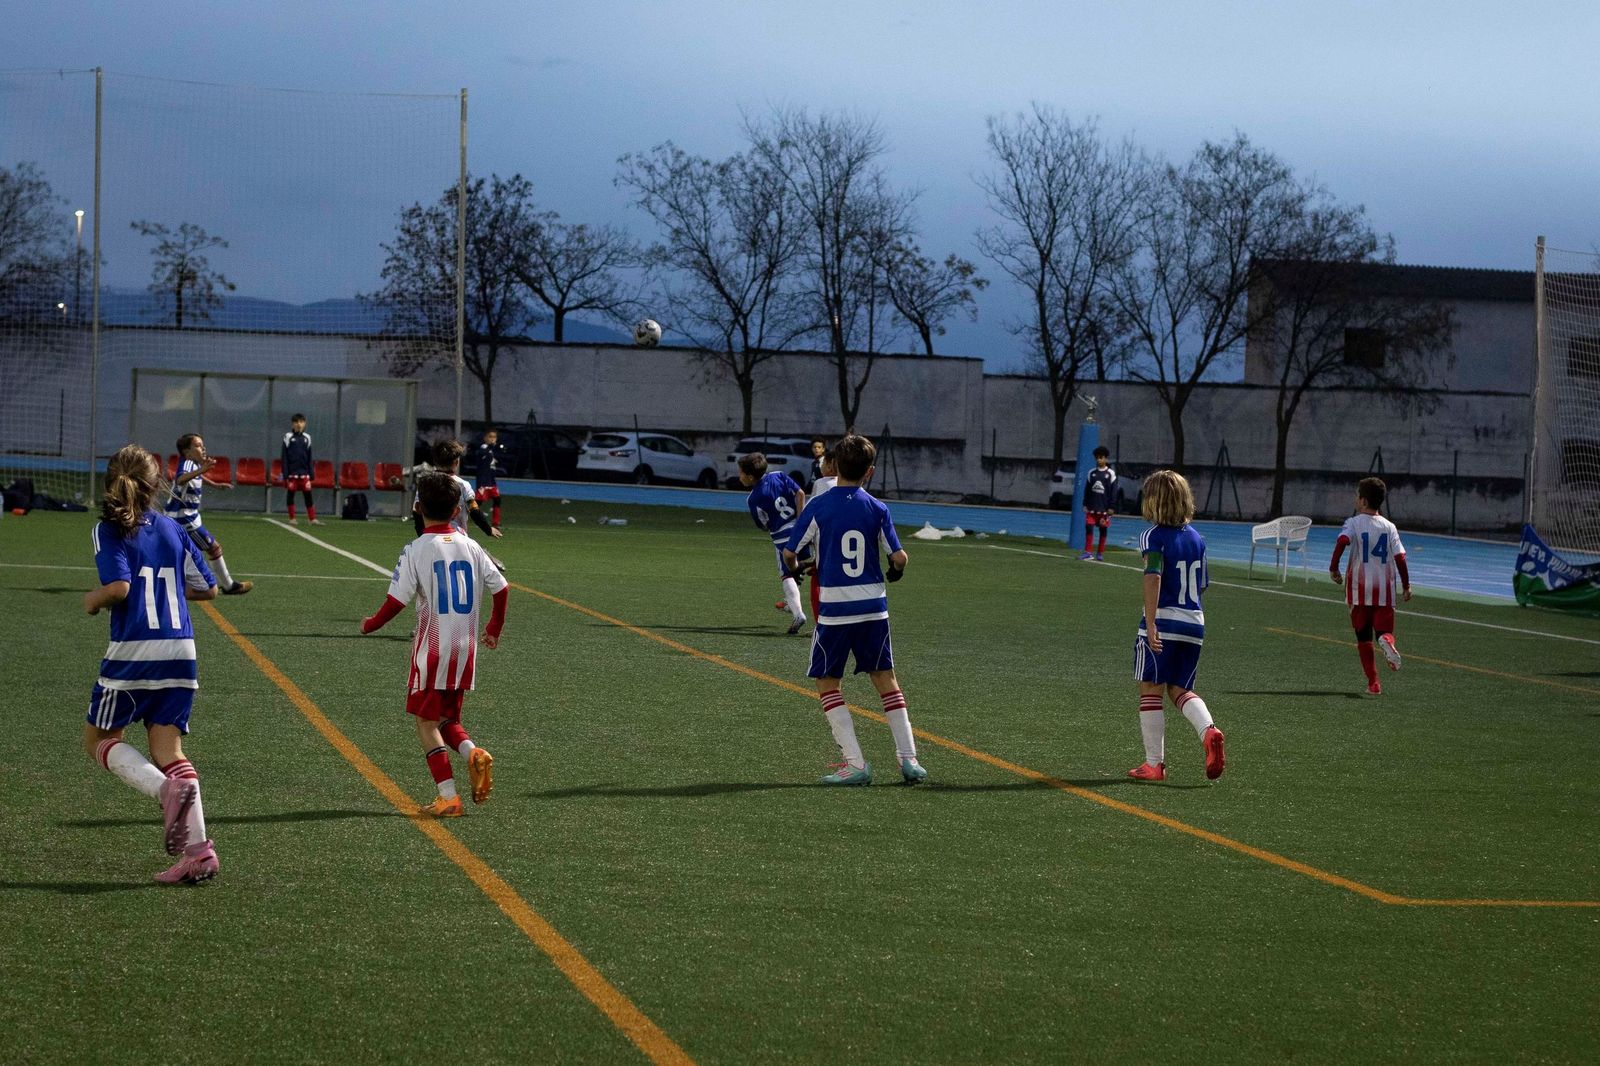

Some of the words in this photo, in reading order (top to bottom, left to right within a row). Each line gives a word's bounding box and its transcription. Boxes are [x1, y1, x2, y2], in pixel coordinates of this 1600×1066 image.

[774, 496, 795, 520] 8
[841, 530, 866, 577] 9
[1361, 532, 1388, 564] 14
[138, 566, 181, 630] 11
[433, 559, 474, 615] 10
